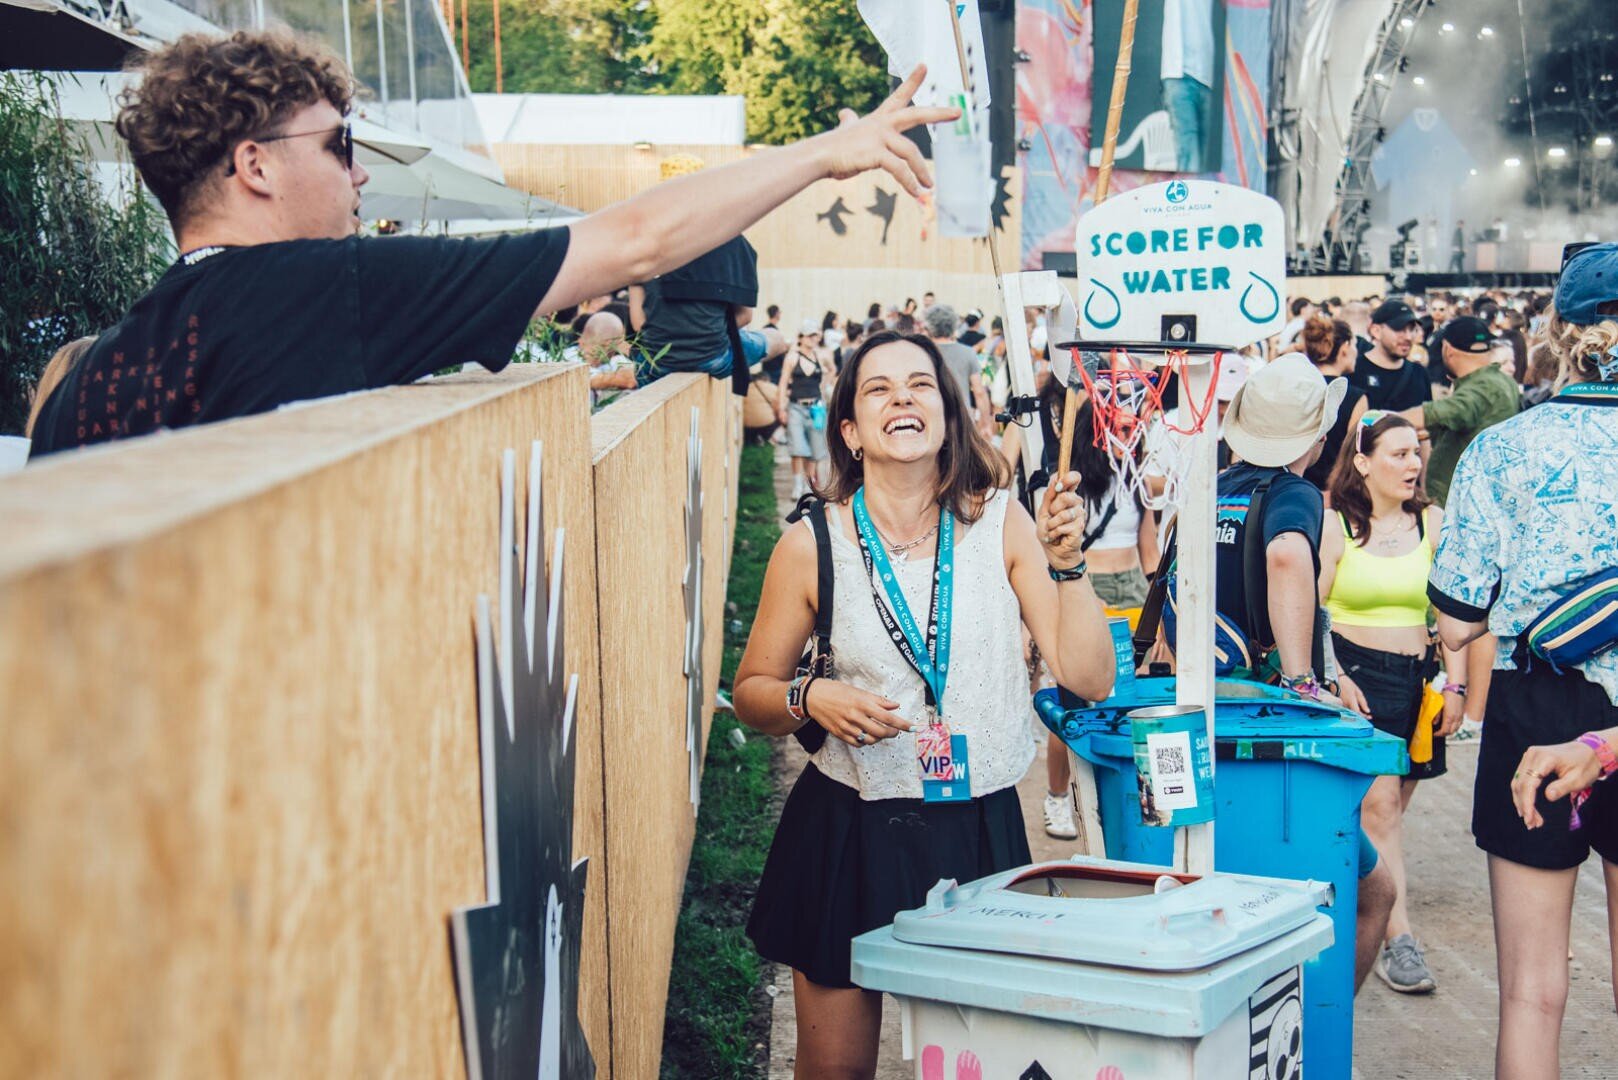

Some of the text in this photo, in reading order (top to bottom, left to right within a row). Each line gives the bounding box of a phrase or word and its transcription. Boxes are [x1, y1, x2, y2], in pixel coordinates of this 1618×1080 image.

[1091, 223, 1263, 257] SCORE FOR
[1123, 267, 1230, 294] WATER
[862, 521, 874, 538] CON
[870, 540, 883, 561] AGUA
[893, 592, 923, 654] VIVA CON AGUA
[940, 632, 948, 650] VIVA
[919, 756, 951, 774] VIP
